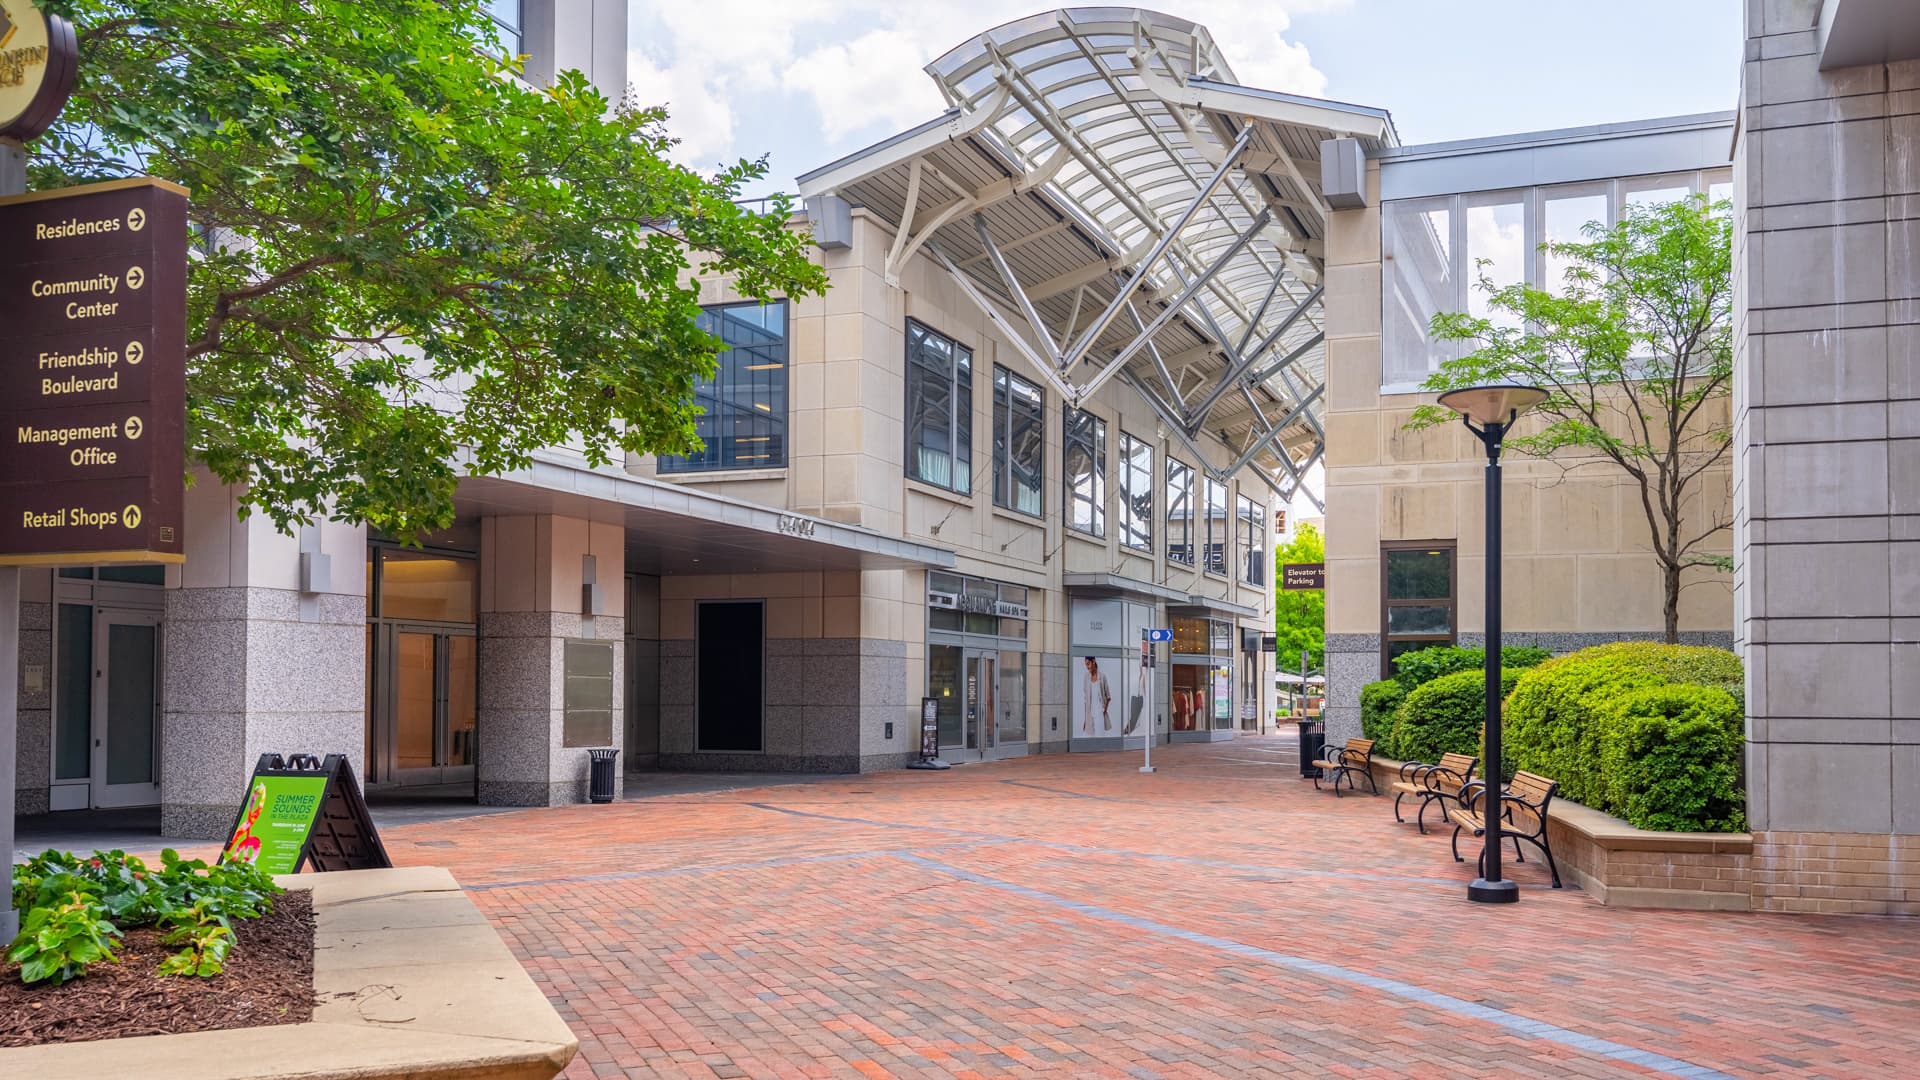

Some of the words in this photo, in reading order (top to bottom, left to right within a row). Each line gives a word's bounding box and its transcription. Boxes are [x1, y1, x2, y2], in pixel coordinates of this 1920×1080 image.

[36, 217, 120, 241] Residences
[31, 273, 119, 298] Community
[66, 301, 119, 320] Center
[39, 347, 119, 371] Friendship
[42, 372, 118, 395] Boulevard
[18, 423, 118, 446] Management
[70, 447, 117, 466] Office
[23, 509, 66, 528] Retail
[70, 508, 118, 530] Shops
[1288, 577, 1314, 586] Parking
[272, 804, 313, 813] SOUNDS
[275, 794, 315, 803] SUMMER
